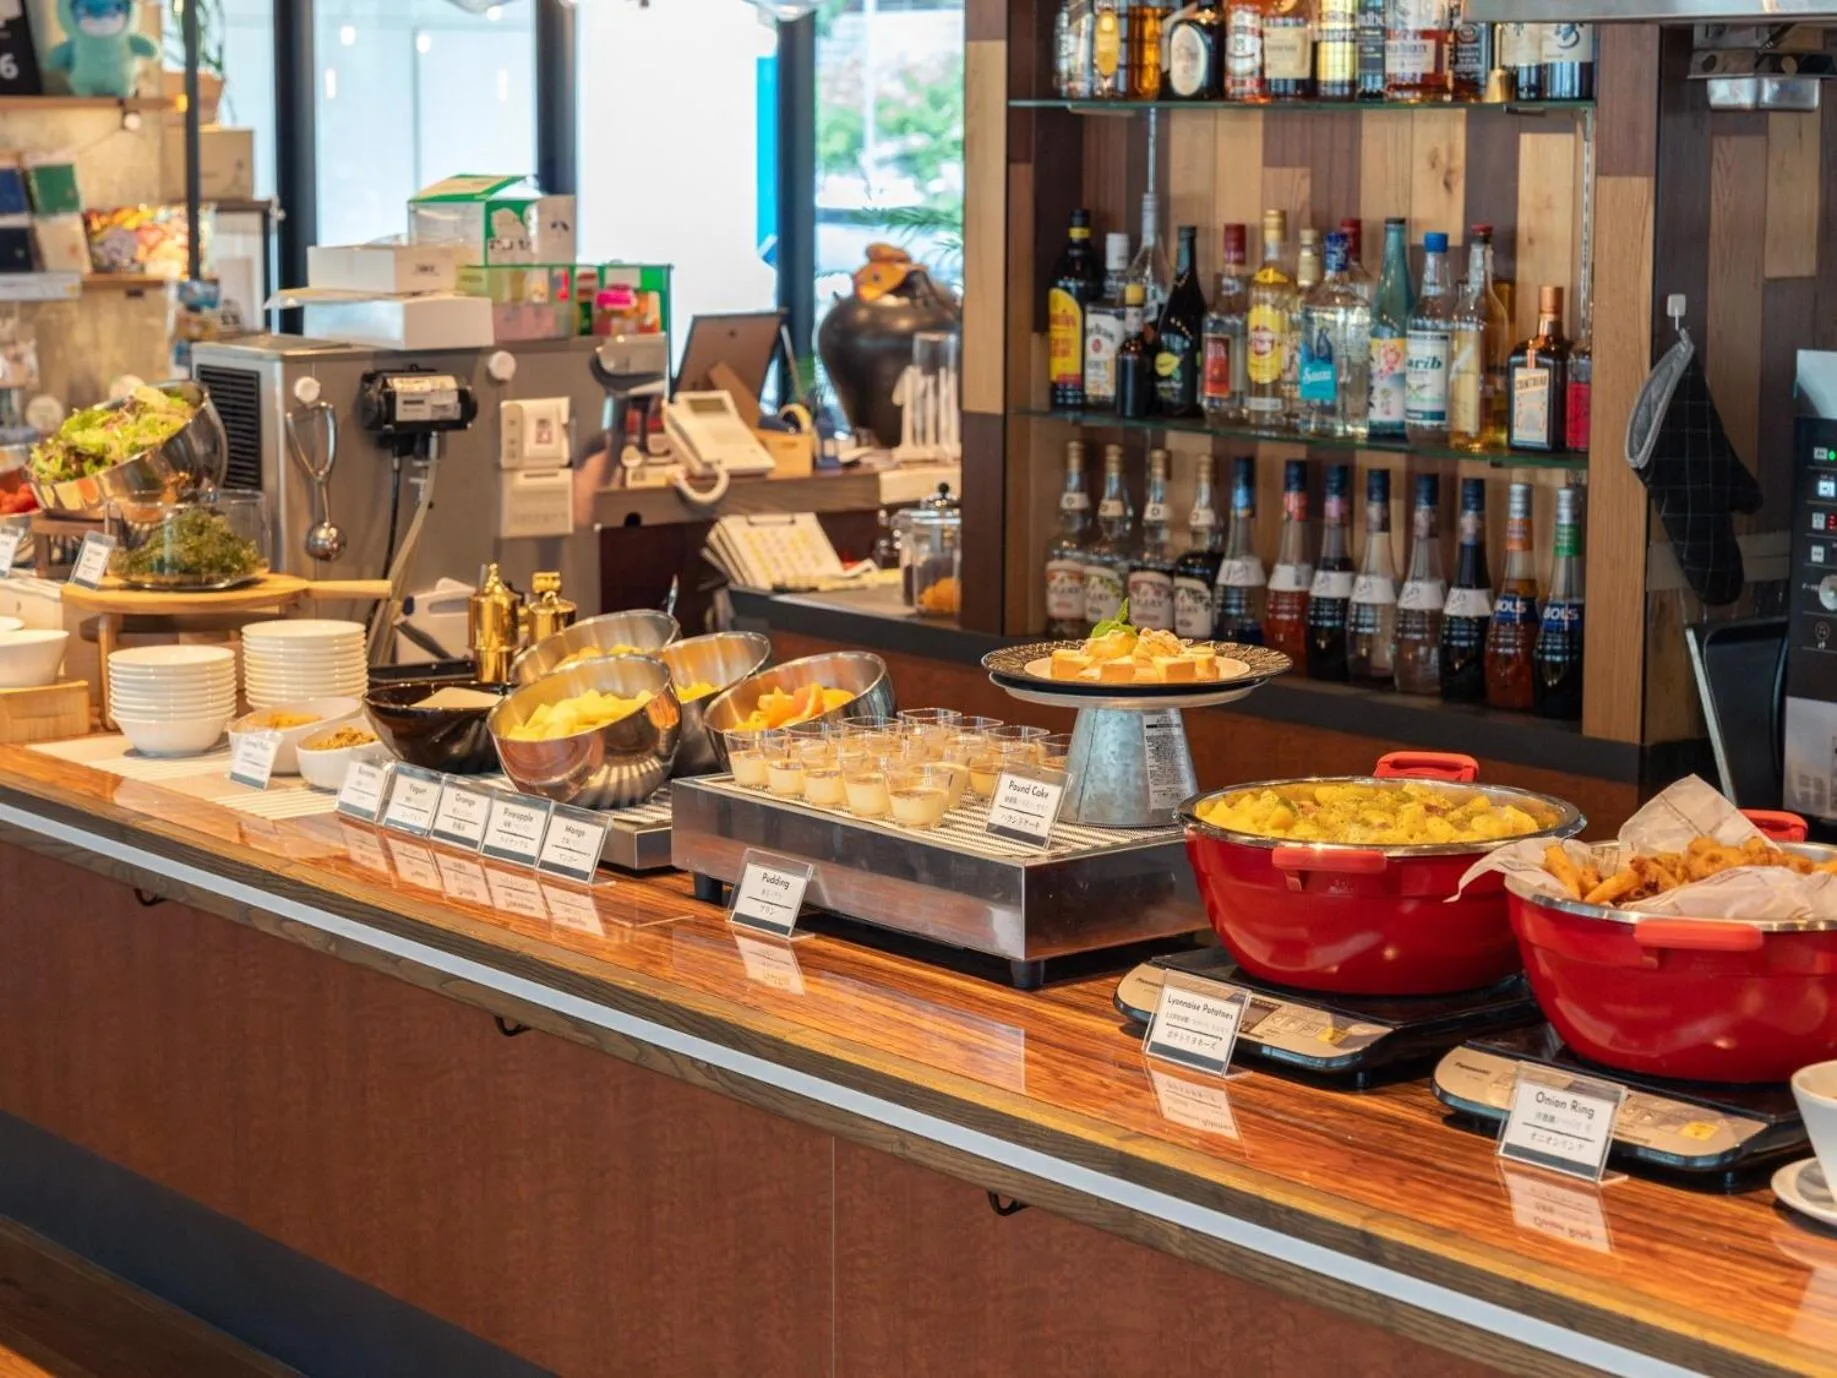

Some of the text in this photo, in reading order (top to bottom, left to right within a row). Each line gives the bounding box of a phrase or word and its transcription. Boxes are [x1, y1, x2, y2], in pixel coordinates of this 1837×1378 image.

[762, 872, 791, 891] Pudding
[1535, 1091, 1596, 1120] Onion Ring
